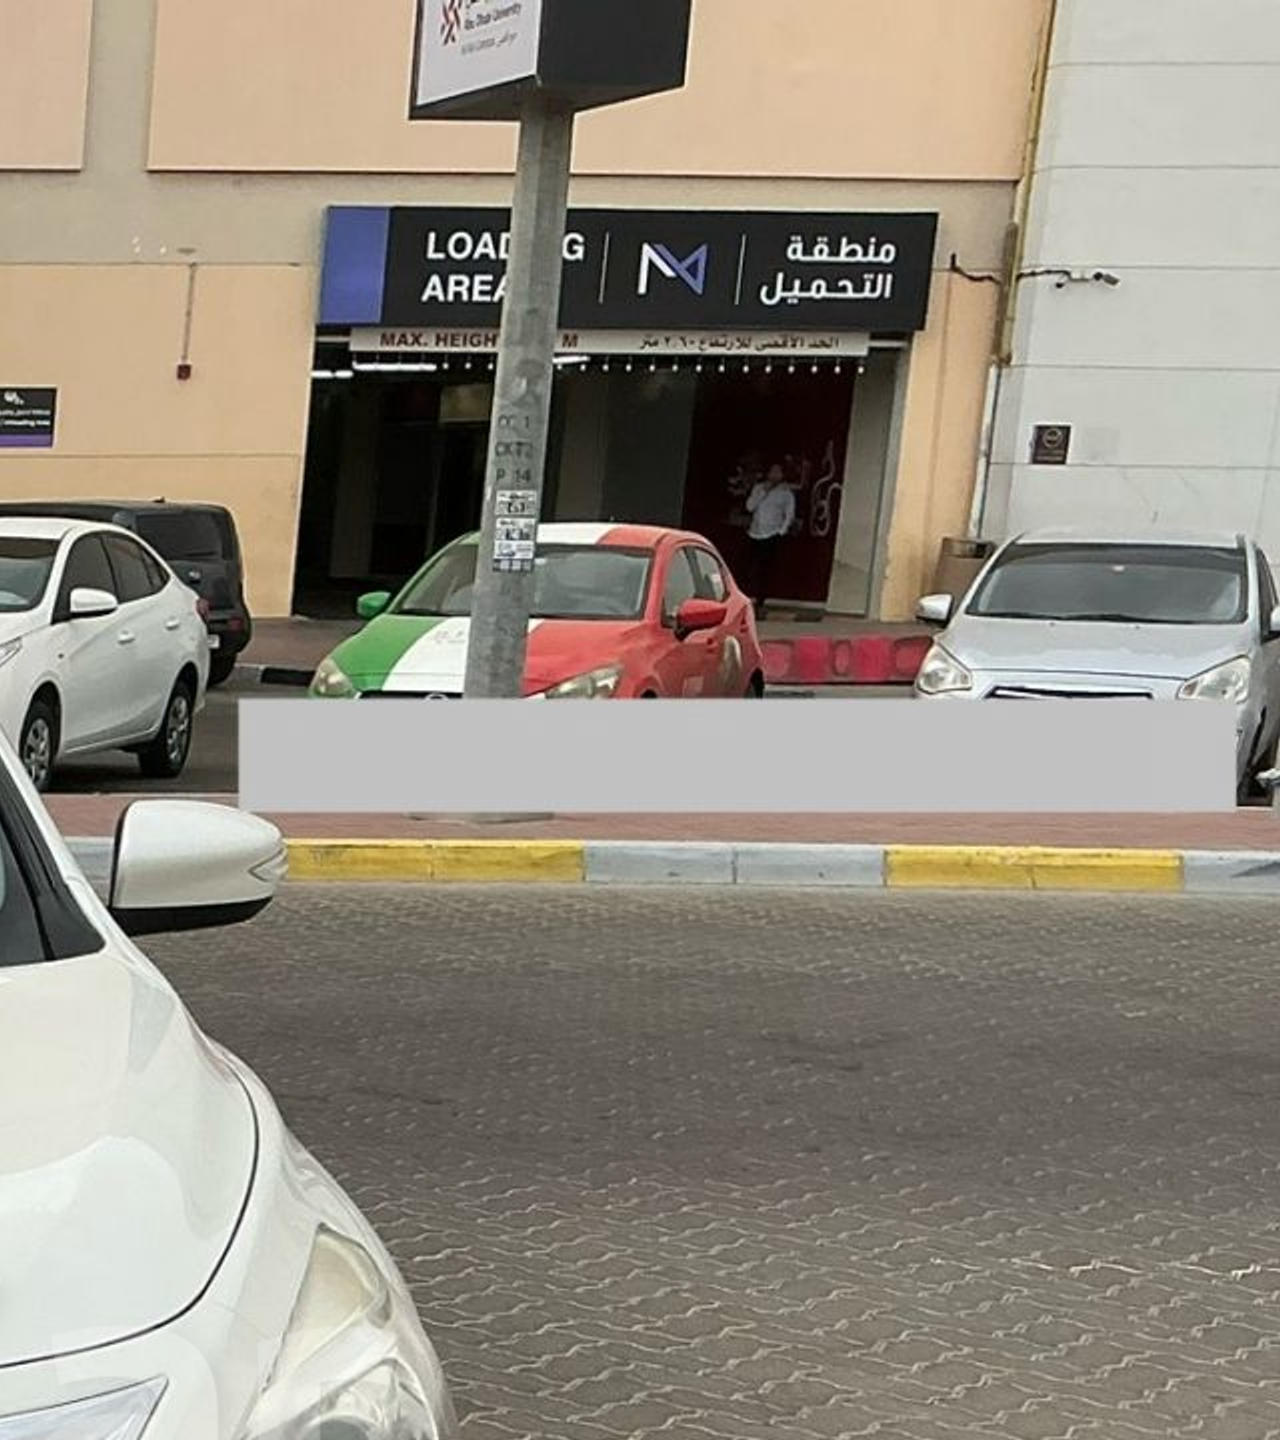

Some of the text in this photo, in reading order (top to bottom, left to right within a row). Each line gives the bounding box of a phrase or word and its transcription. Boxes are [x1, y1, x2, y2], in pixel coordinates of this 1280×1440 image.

[426, 231, 586, 261] LOAG
[786, 234, 896, 264] منطقة
[759, 271, 894, 306] التحميل
[379, 332, 429, 349] MAX.
[434, 332, 498, 349] HEIGH
